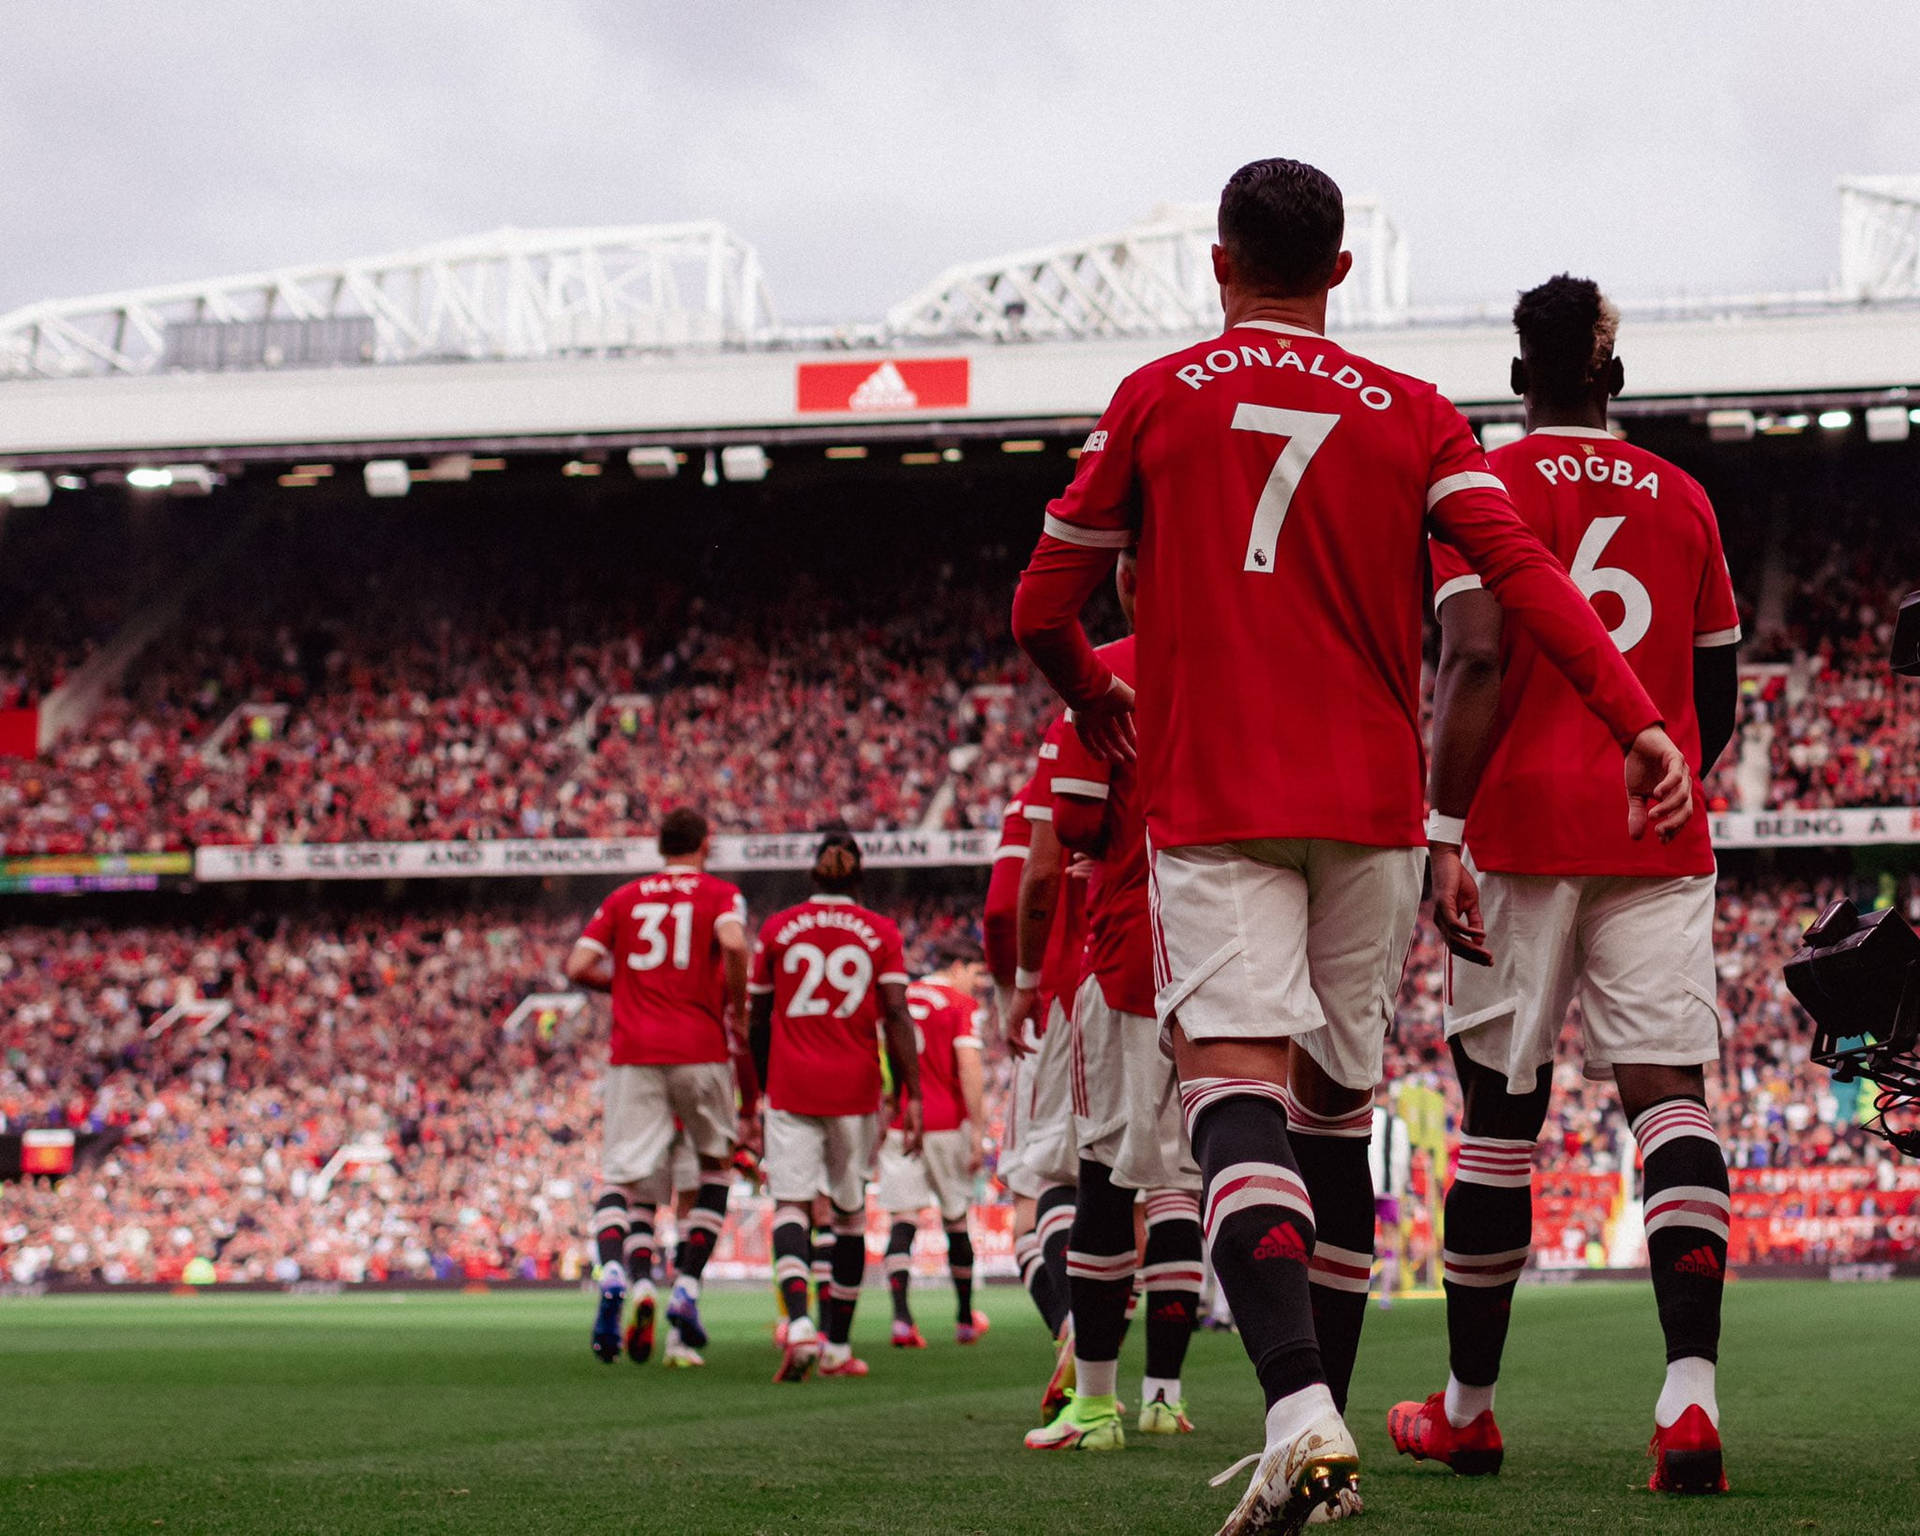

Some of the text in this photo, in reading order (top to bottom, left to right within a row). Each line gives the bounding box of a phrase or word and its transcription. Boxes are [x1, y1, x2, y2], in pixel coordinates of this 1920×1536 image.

[1175, 345, 1393, 411] RONALDO
[1230, 402, 1341, 573] 7
[1535, 454, 1660, 499] POGBA
[1569, 515, 1652, 653] 6
[425, 849, 483, 865] AND
[743, 842, 819, 859] GREA
[1754, 816, 1843, 837] BEING
[1868, 814, 1887, 834] A
[626, 901, 694, 971] 31
[783, 942, 873, 1018] 29
